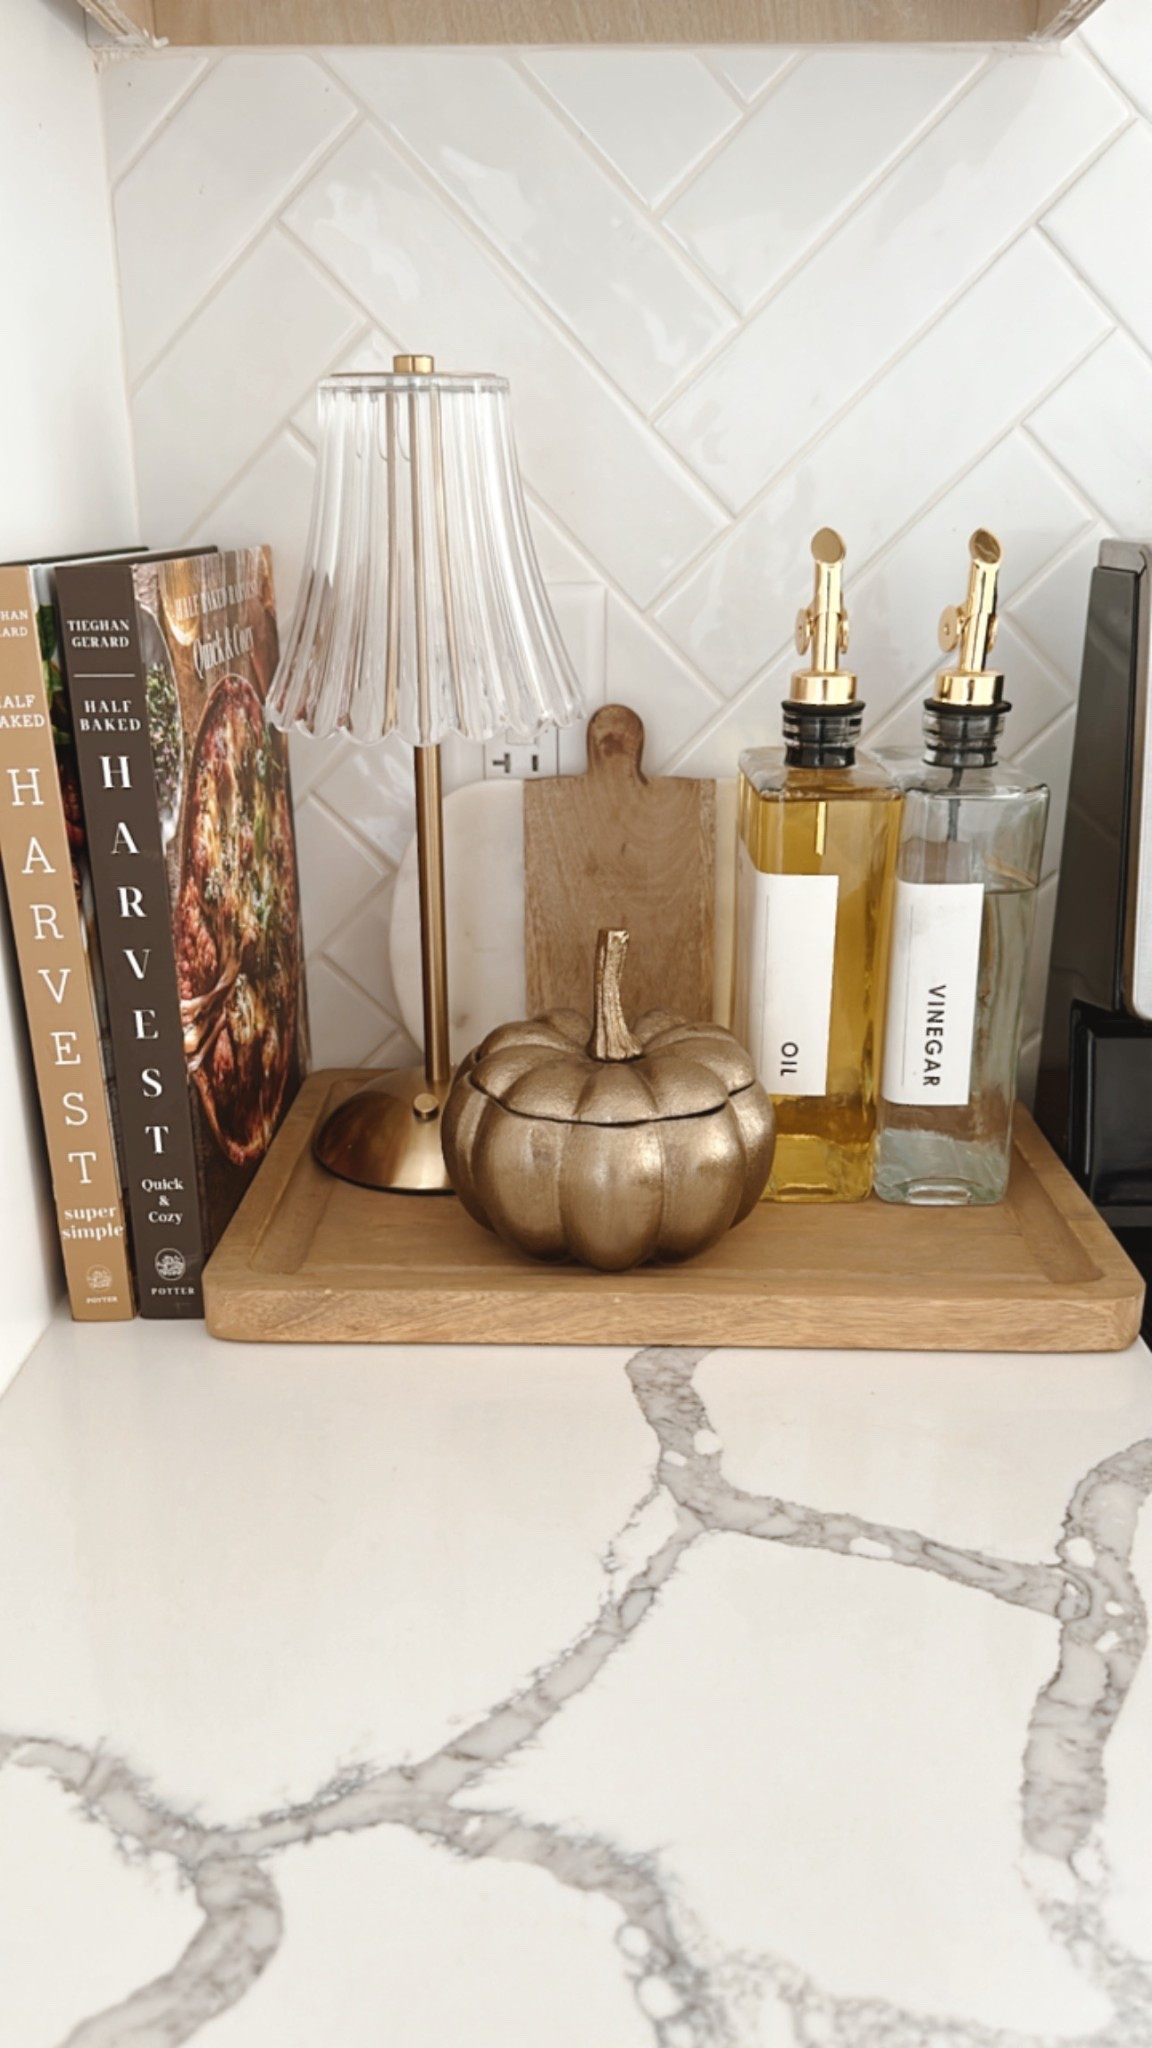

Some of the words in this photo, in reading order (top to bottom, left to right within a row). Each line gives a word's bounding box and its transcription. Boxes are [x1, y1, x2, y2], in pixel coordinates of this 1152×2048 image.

[0, 609, 29, 621] HAN
[0, 626, 29, 638] ARD
[67, 619, 130, 632] TIEGHAN
[71, 636, 130, 648] GERARD
[0, 694, 36, 709] ALF
[84, 700, 132, 713] HALF
[0, 713, 45, 729] AKED
[80, 718, 141, 731] BAKED
[100, 756, 169, 1154] HARVEST
[6, 767, 97, 1184] HARVEST
[922, 984, 947, 1087] VINEGAR
[780, 1042, 799, 1077] OIL
[141, 1178, 184, 1193] Quick
[159, 1195, 170, 1207] &
[63, 1205, 117, 1222] super
[148, 1211, 183, 1225] Cozy
[61, 1222, 124, 1241] simple
[151, 1287, 195, 1296] POTTER
